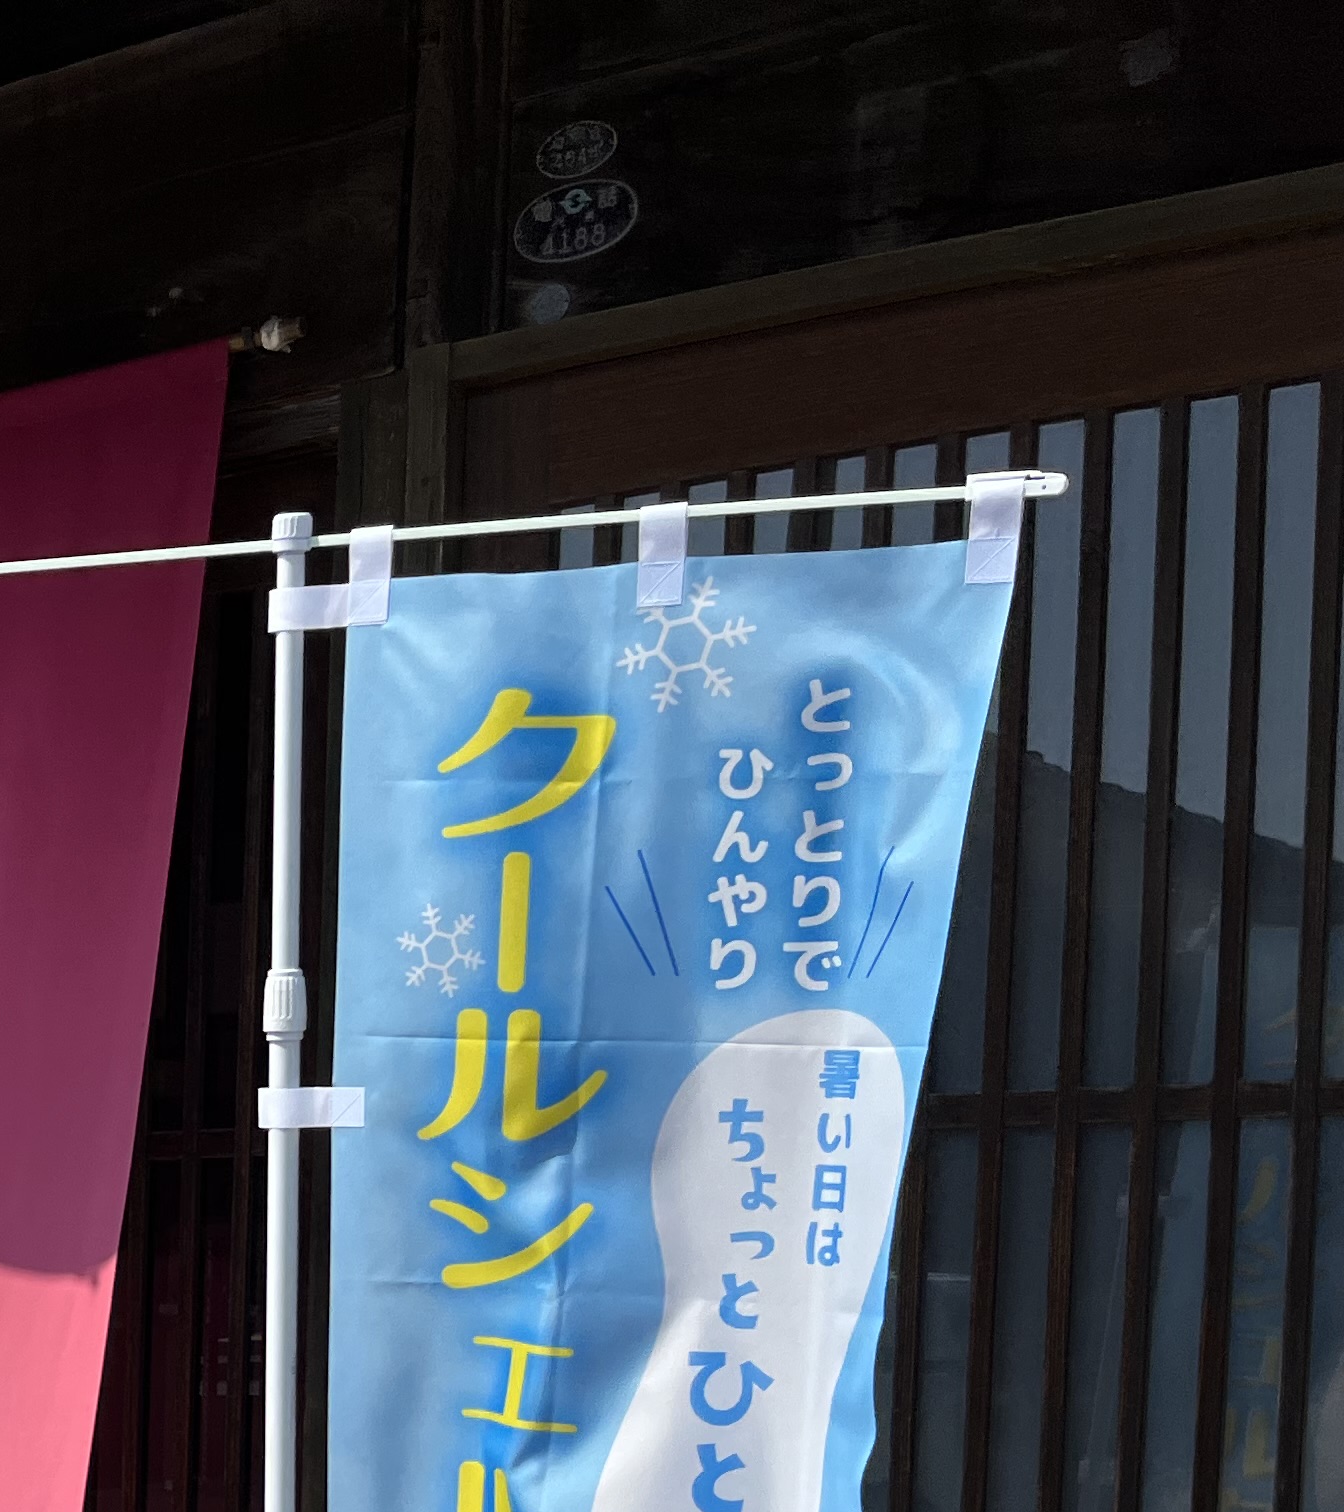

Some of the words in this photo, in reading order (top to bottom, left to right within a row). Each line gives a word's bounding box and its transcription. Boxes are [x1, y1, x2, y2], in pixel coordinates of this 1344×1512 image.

[707, 747, 775, 991] ひんやり
[782, 678, 853, 994] とっとりで
[806, 1049, 861, 1268] 暑い日は
